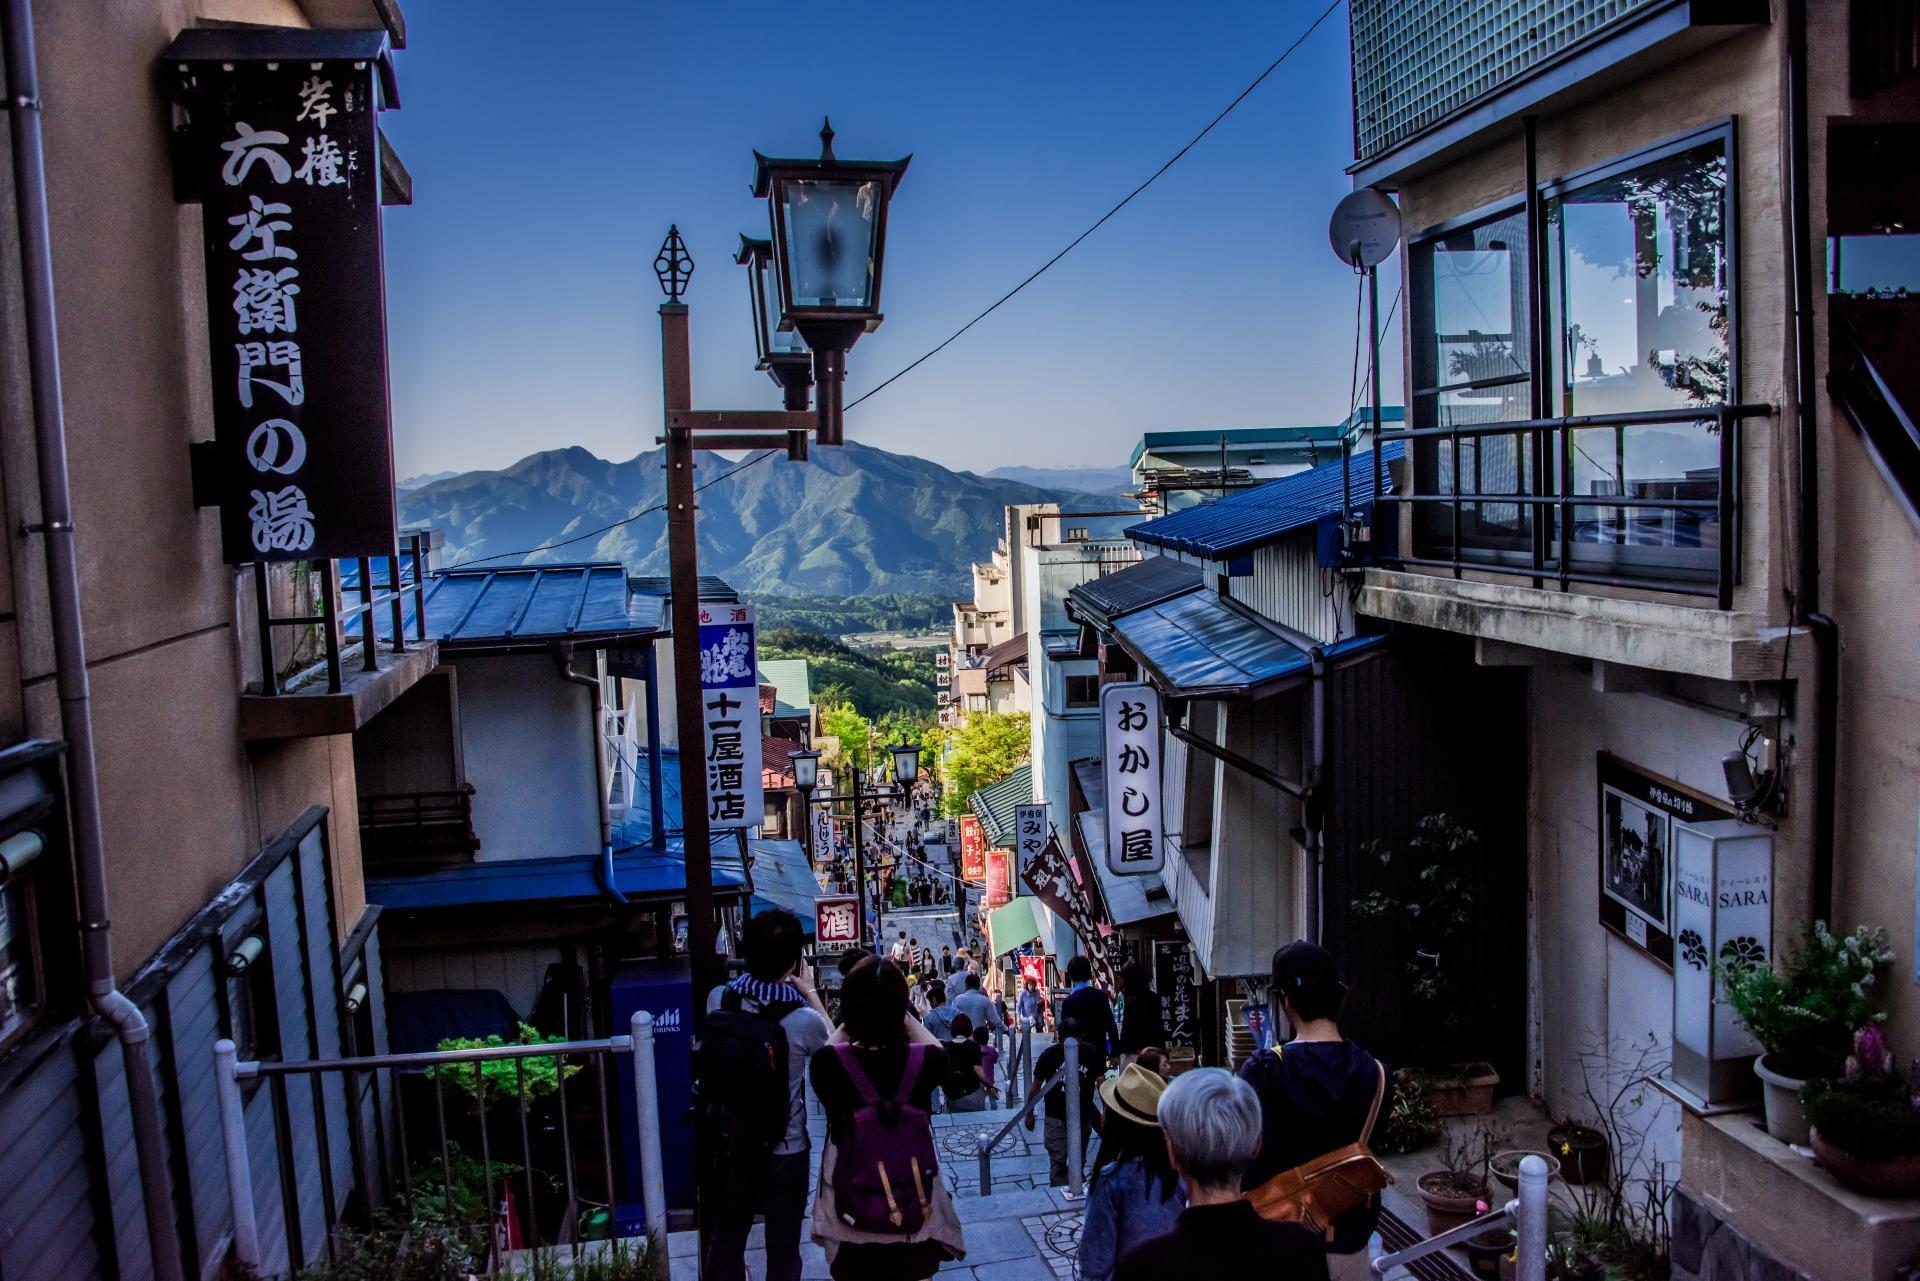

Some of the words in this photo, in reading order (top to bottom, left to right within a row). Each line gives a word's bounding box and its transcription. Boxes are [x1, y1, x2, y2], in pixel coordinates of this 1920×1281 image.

[220, 120, 316, 553] 六左衛門の湯
[938, 656, 949, 722] 村松旅館
[706, 691, 745, 822] 十一屋酒店
[1118, 700, 1154, 862] おかし屋
[1019, 809, 1043, 819] 伊香保
[1678, 881, 1710, 907] SARA
[1719, 889, 1768, 908] SARA
[820, 903, 855, 938] 酒
[652, 1008, 681, 1027] ahi
